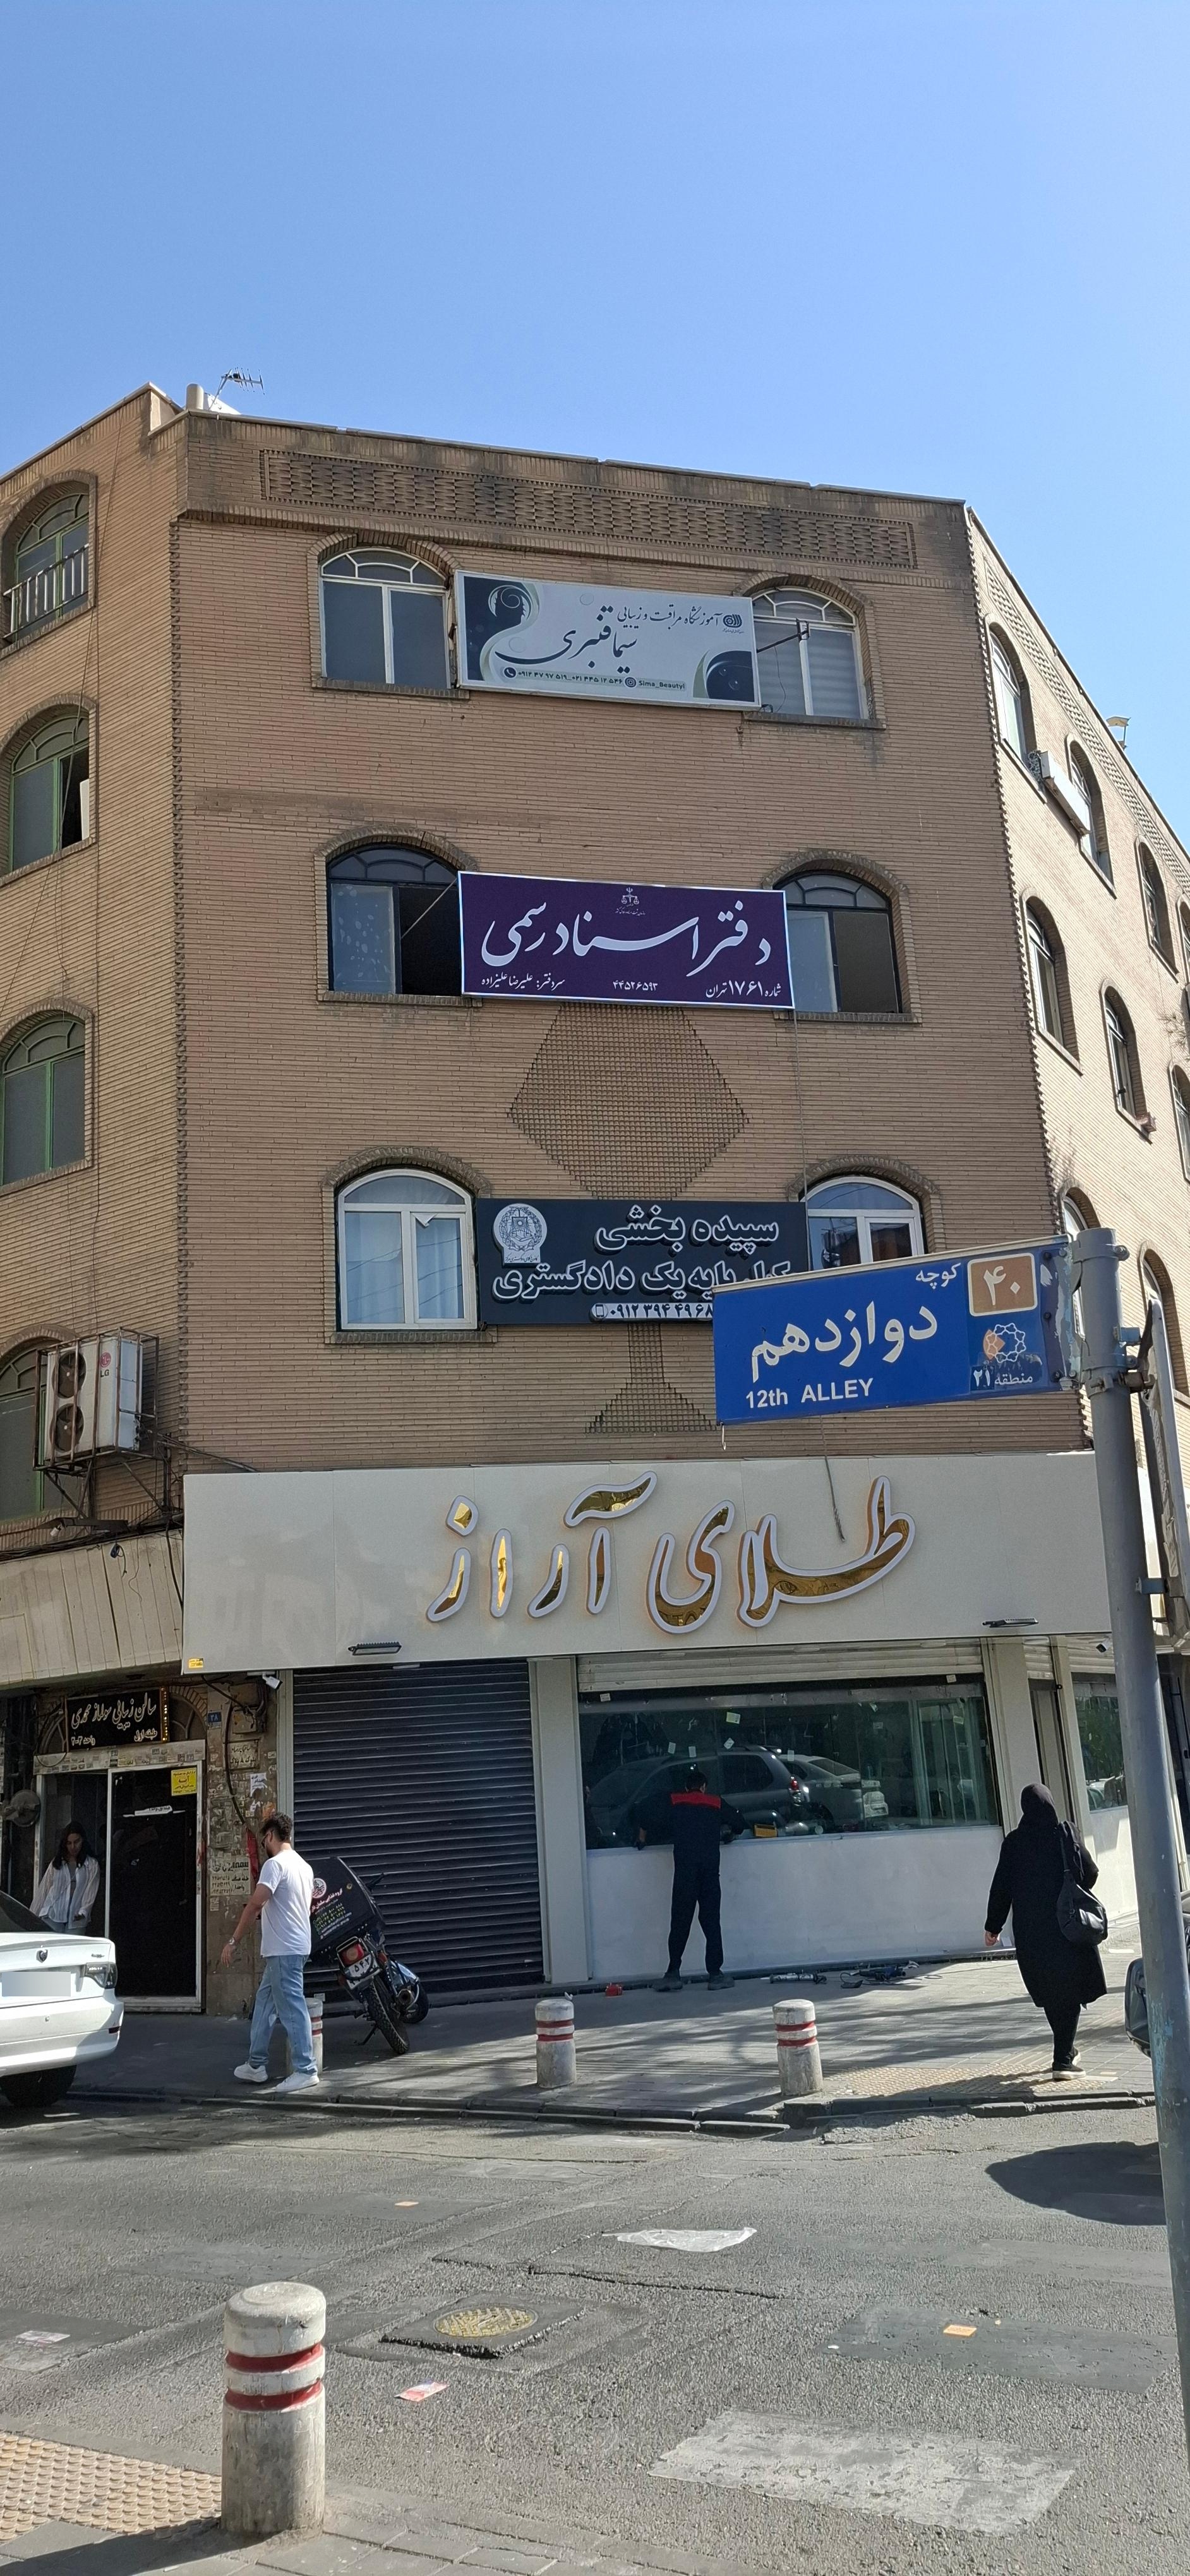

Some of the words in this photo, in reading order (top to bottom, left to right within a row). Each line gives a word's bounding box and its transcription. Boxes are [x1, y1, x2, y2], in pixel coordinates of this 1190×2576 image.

[617, 606, 642, 629] زیبایی
[649, 604, 682, 630] مراقبت
[683, 606, 723, 626] آموزشگاه
[495, 605, 614, 668] قنبری
[612, 628, 638, 674] سیما
[481, 902, 547, 967] رسمی
[552, 910, 699, 960] اسناد
[686, 900, 772, 977] دفتر
[508, 972, 533, 990] علیرضا
[613, 980, 658, 991] ۴۴۵۲۶۵۹۳
[706, 982, 728, 998] تهران
[728, 979, 763, 996] ۱۷۶۱
[764, 983, 781, 997] شماره
[594, 1204, 686, 1253] بخشی
[692, 1214, 779, 1255] سپیده
[492, 1259, 636, 1299] دادگستری
[641, 1260, 686, 1299] یک
[915, 1262, 961, 1290] کوچه
[982, 1265, 1021, 1306] ۴۰
[610, 1303, 639, 1318] ۰۹۱۲
[643, 1303, 671, 1318] ۳۹۴
[675, 1303, 692, 1318] ۴۹
[751, 1301, 938, 1383] دوازدهم
[100, 1369, 109, 1378] LG
[973, 1369, 990, 1387] ۲۱
[994, 1373, 1033, 1385] منطقه
[746, 1388, 789, 1409] 12th
[801, 1378, 874, 1403] ALLEY
[426, 1470, 659, 1624] آراز
[646, 1475, 917, 1635] طلای
